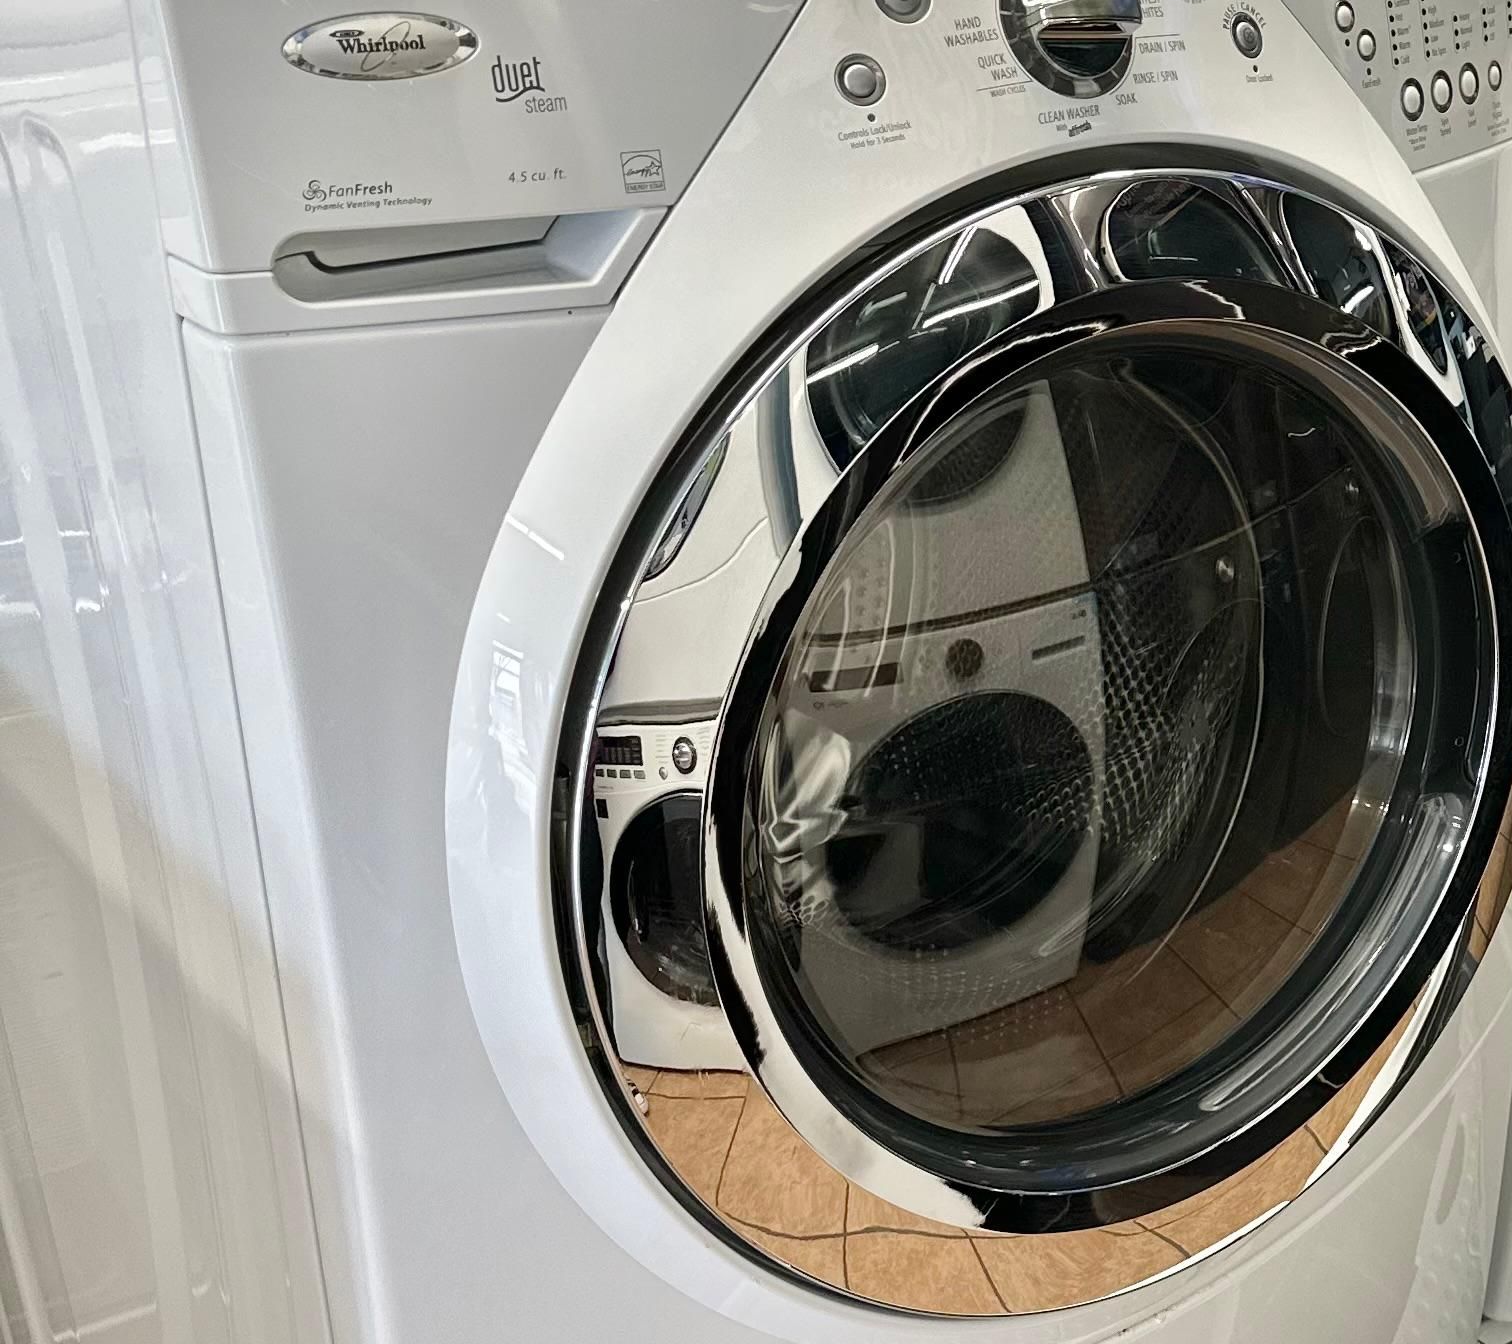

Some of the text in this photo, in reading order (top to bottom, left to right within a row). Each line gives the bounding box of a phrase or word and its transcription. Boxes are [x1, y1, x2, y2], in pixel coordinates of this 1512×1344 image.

[1143, 6, 1164, 18] HITES
[954, 16, 981, 31] HAND
[336, 34, 426, 55] Whirlpool
[944, 28, 999, 48] WASHABLES
[1139, 40, 1186, 54] DRAIN SPIN
[977, 53, 1006, 69] QUICK
[491, 55, 543, 94] duet
[991, 67, 1018, 81] WASH
[1132, 70, 1179, 84] RINSE SPIN
[525, 95, 568, 114] steam
[1115, 93, 1138, 106] SOAK
[1038, 105, 1100, 125] CLEAN WASHER
[838, 128, 869, 141] Controls
[328, 181, 393, 198] FanFresh
[305, 195, 433, 212] Dynamic Venting Technology
